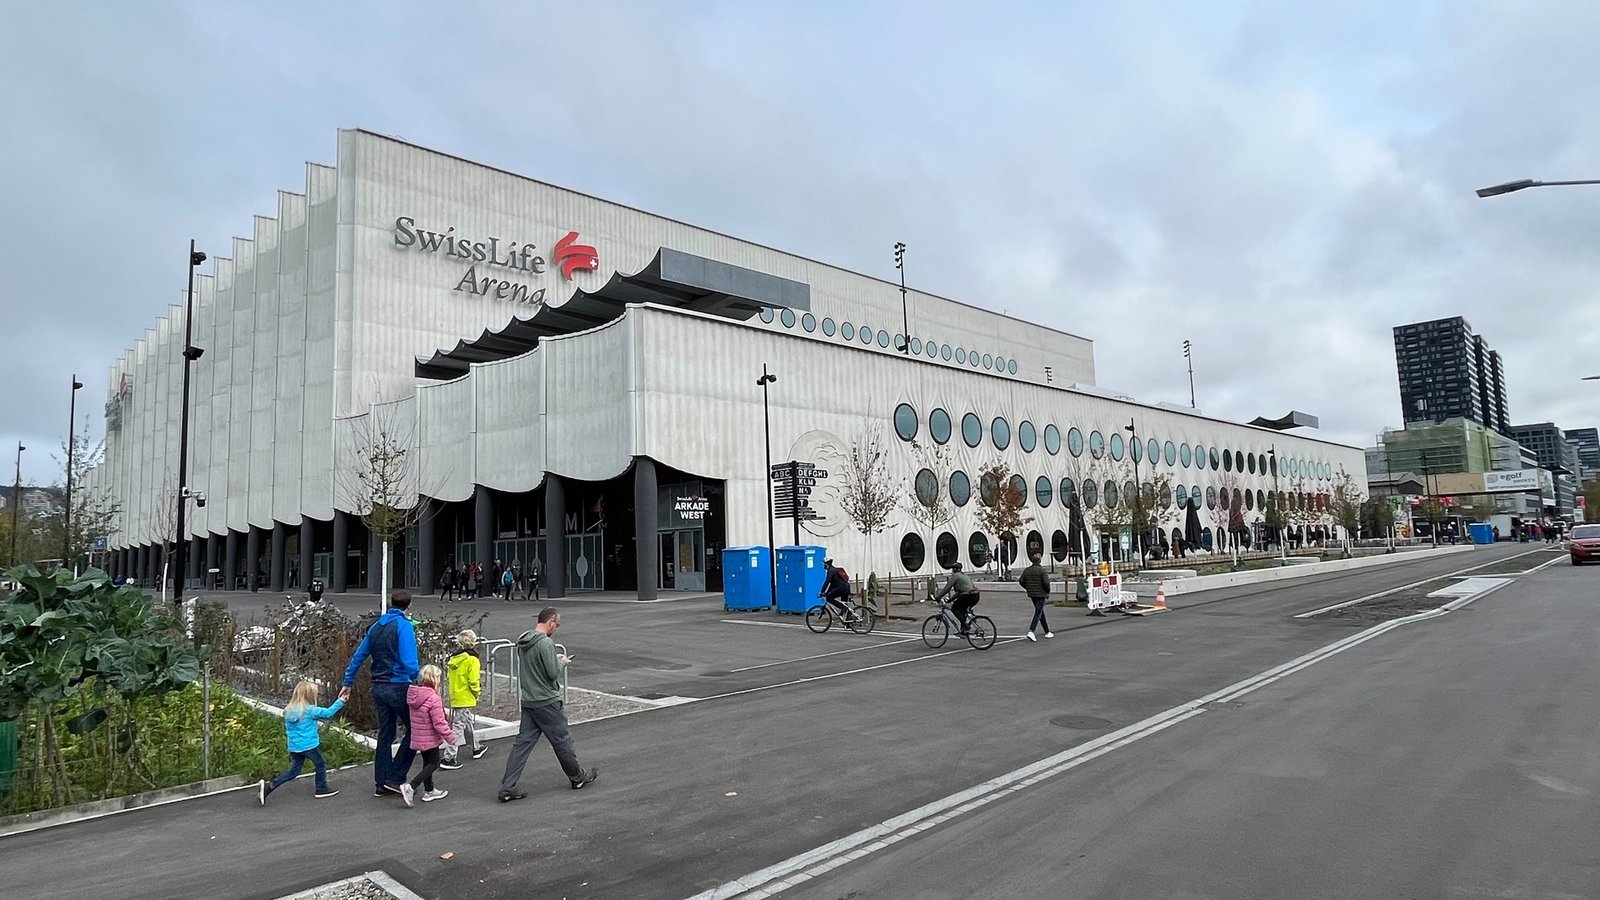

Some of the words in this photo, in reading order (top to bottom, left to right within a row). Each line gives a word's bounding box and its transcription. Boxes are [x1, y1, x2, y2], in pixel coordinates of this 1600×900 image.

[394, 216, 546, 274] SwissLife
[453, 265, 546, 306] Arena
[1500, 472, 1522, 481] egolf
[674, 502, 710, 511] ARKADE
[680, 511, 705, 519] WEST
